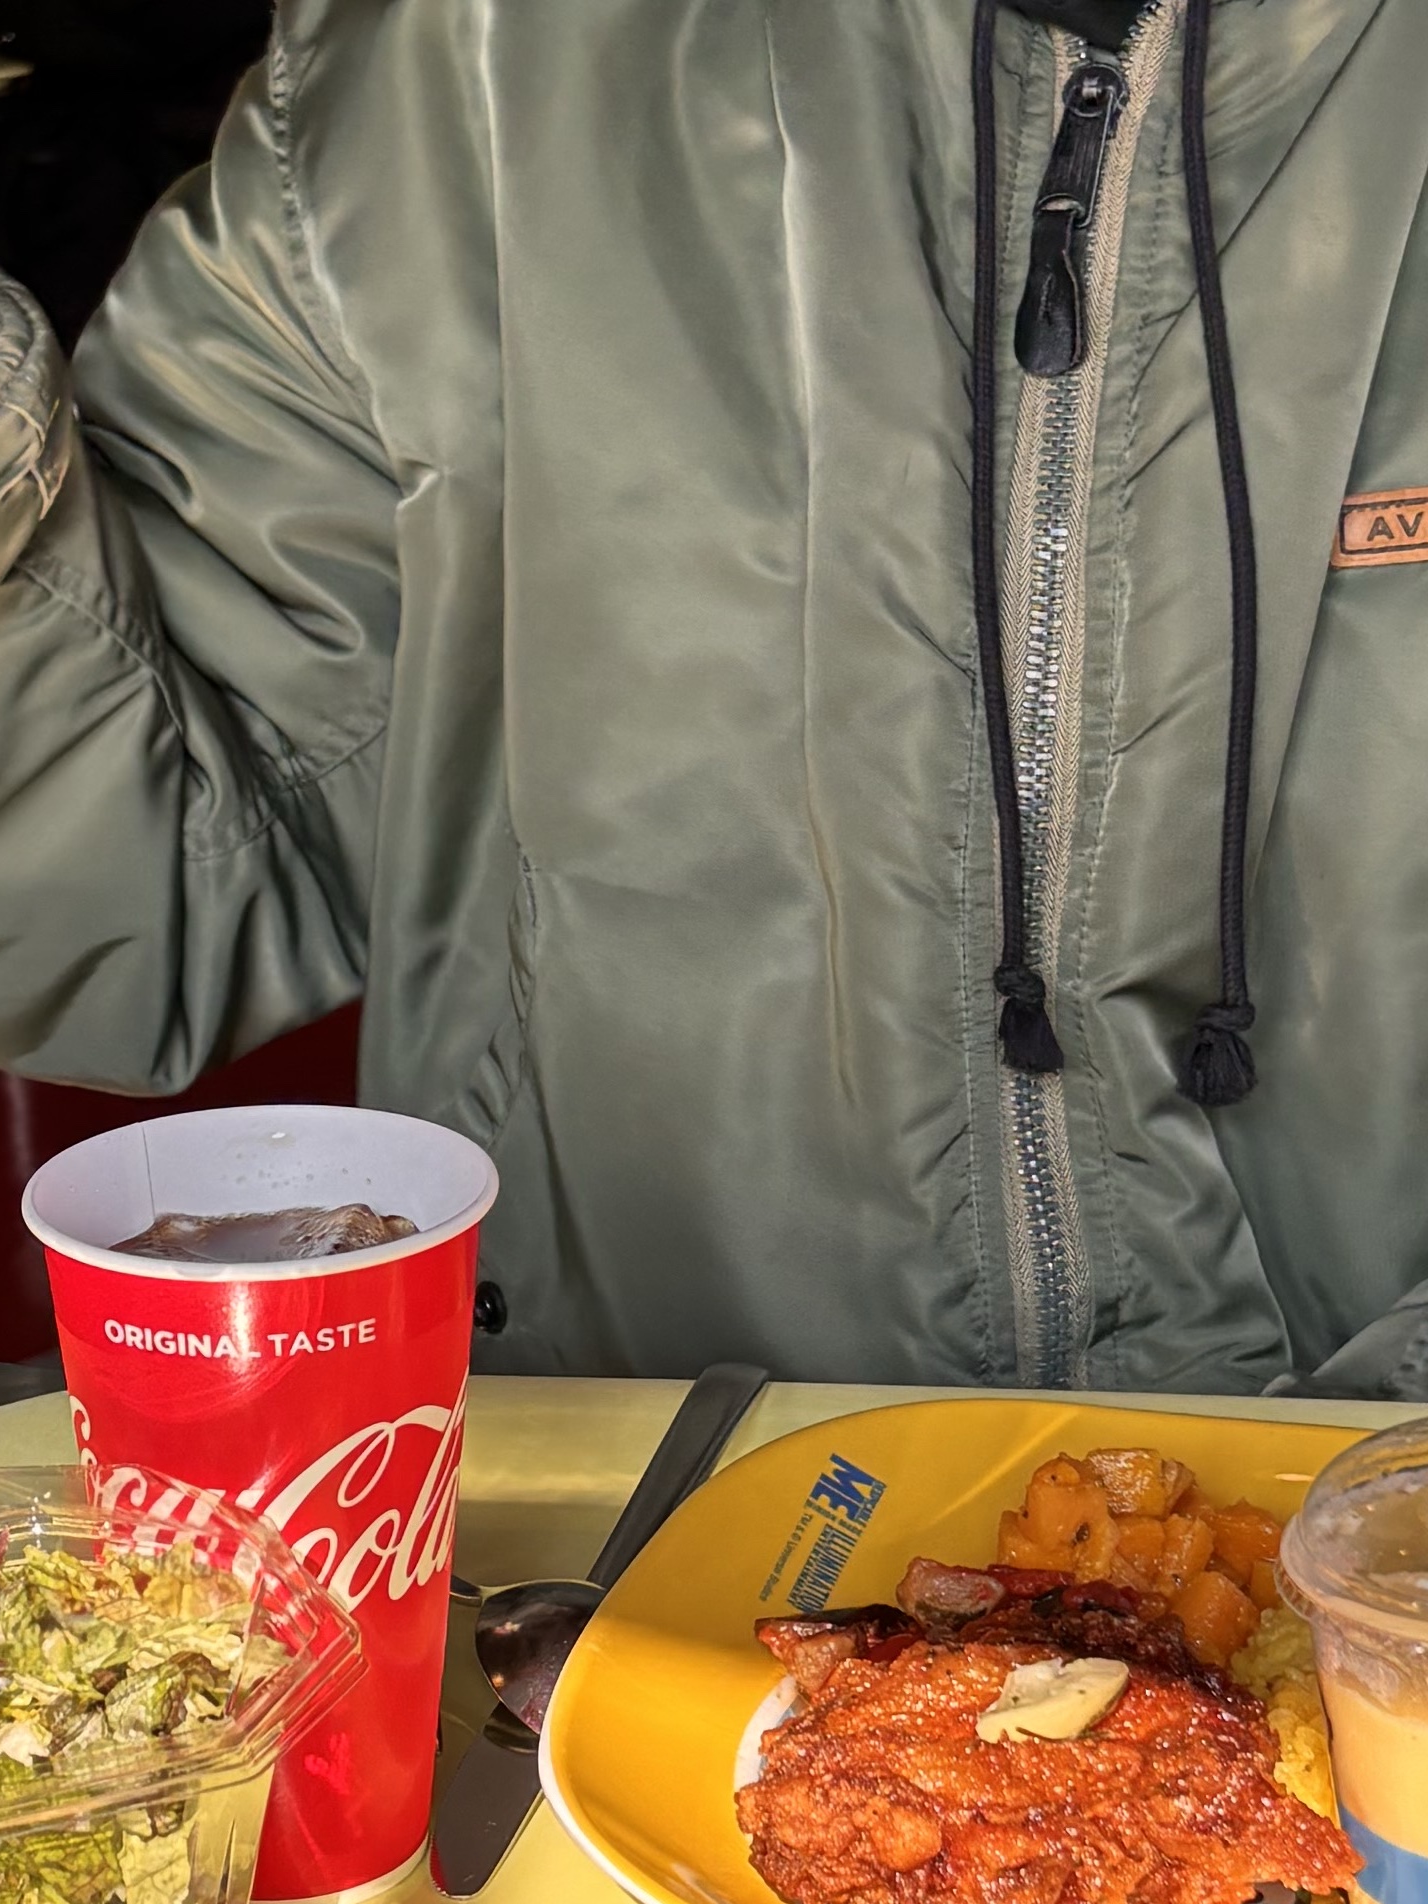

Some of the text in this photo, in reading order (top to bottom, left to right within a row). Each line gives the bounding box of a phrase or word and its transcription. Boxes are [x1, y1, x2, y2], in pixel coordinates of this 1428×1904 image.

[103, 1317, 377, 1359] ORIGINAL TASTE
[809, 1452, 875, 1521] ME
